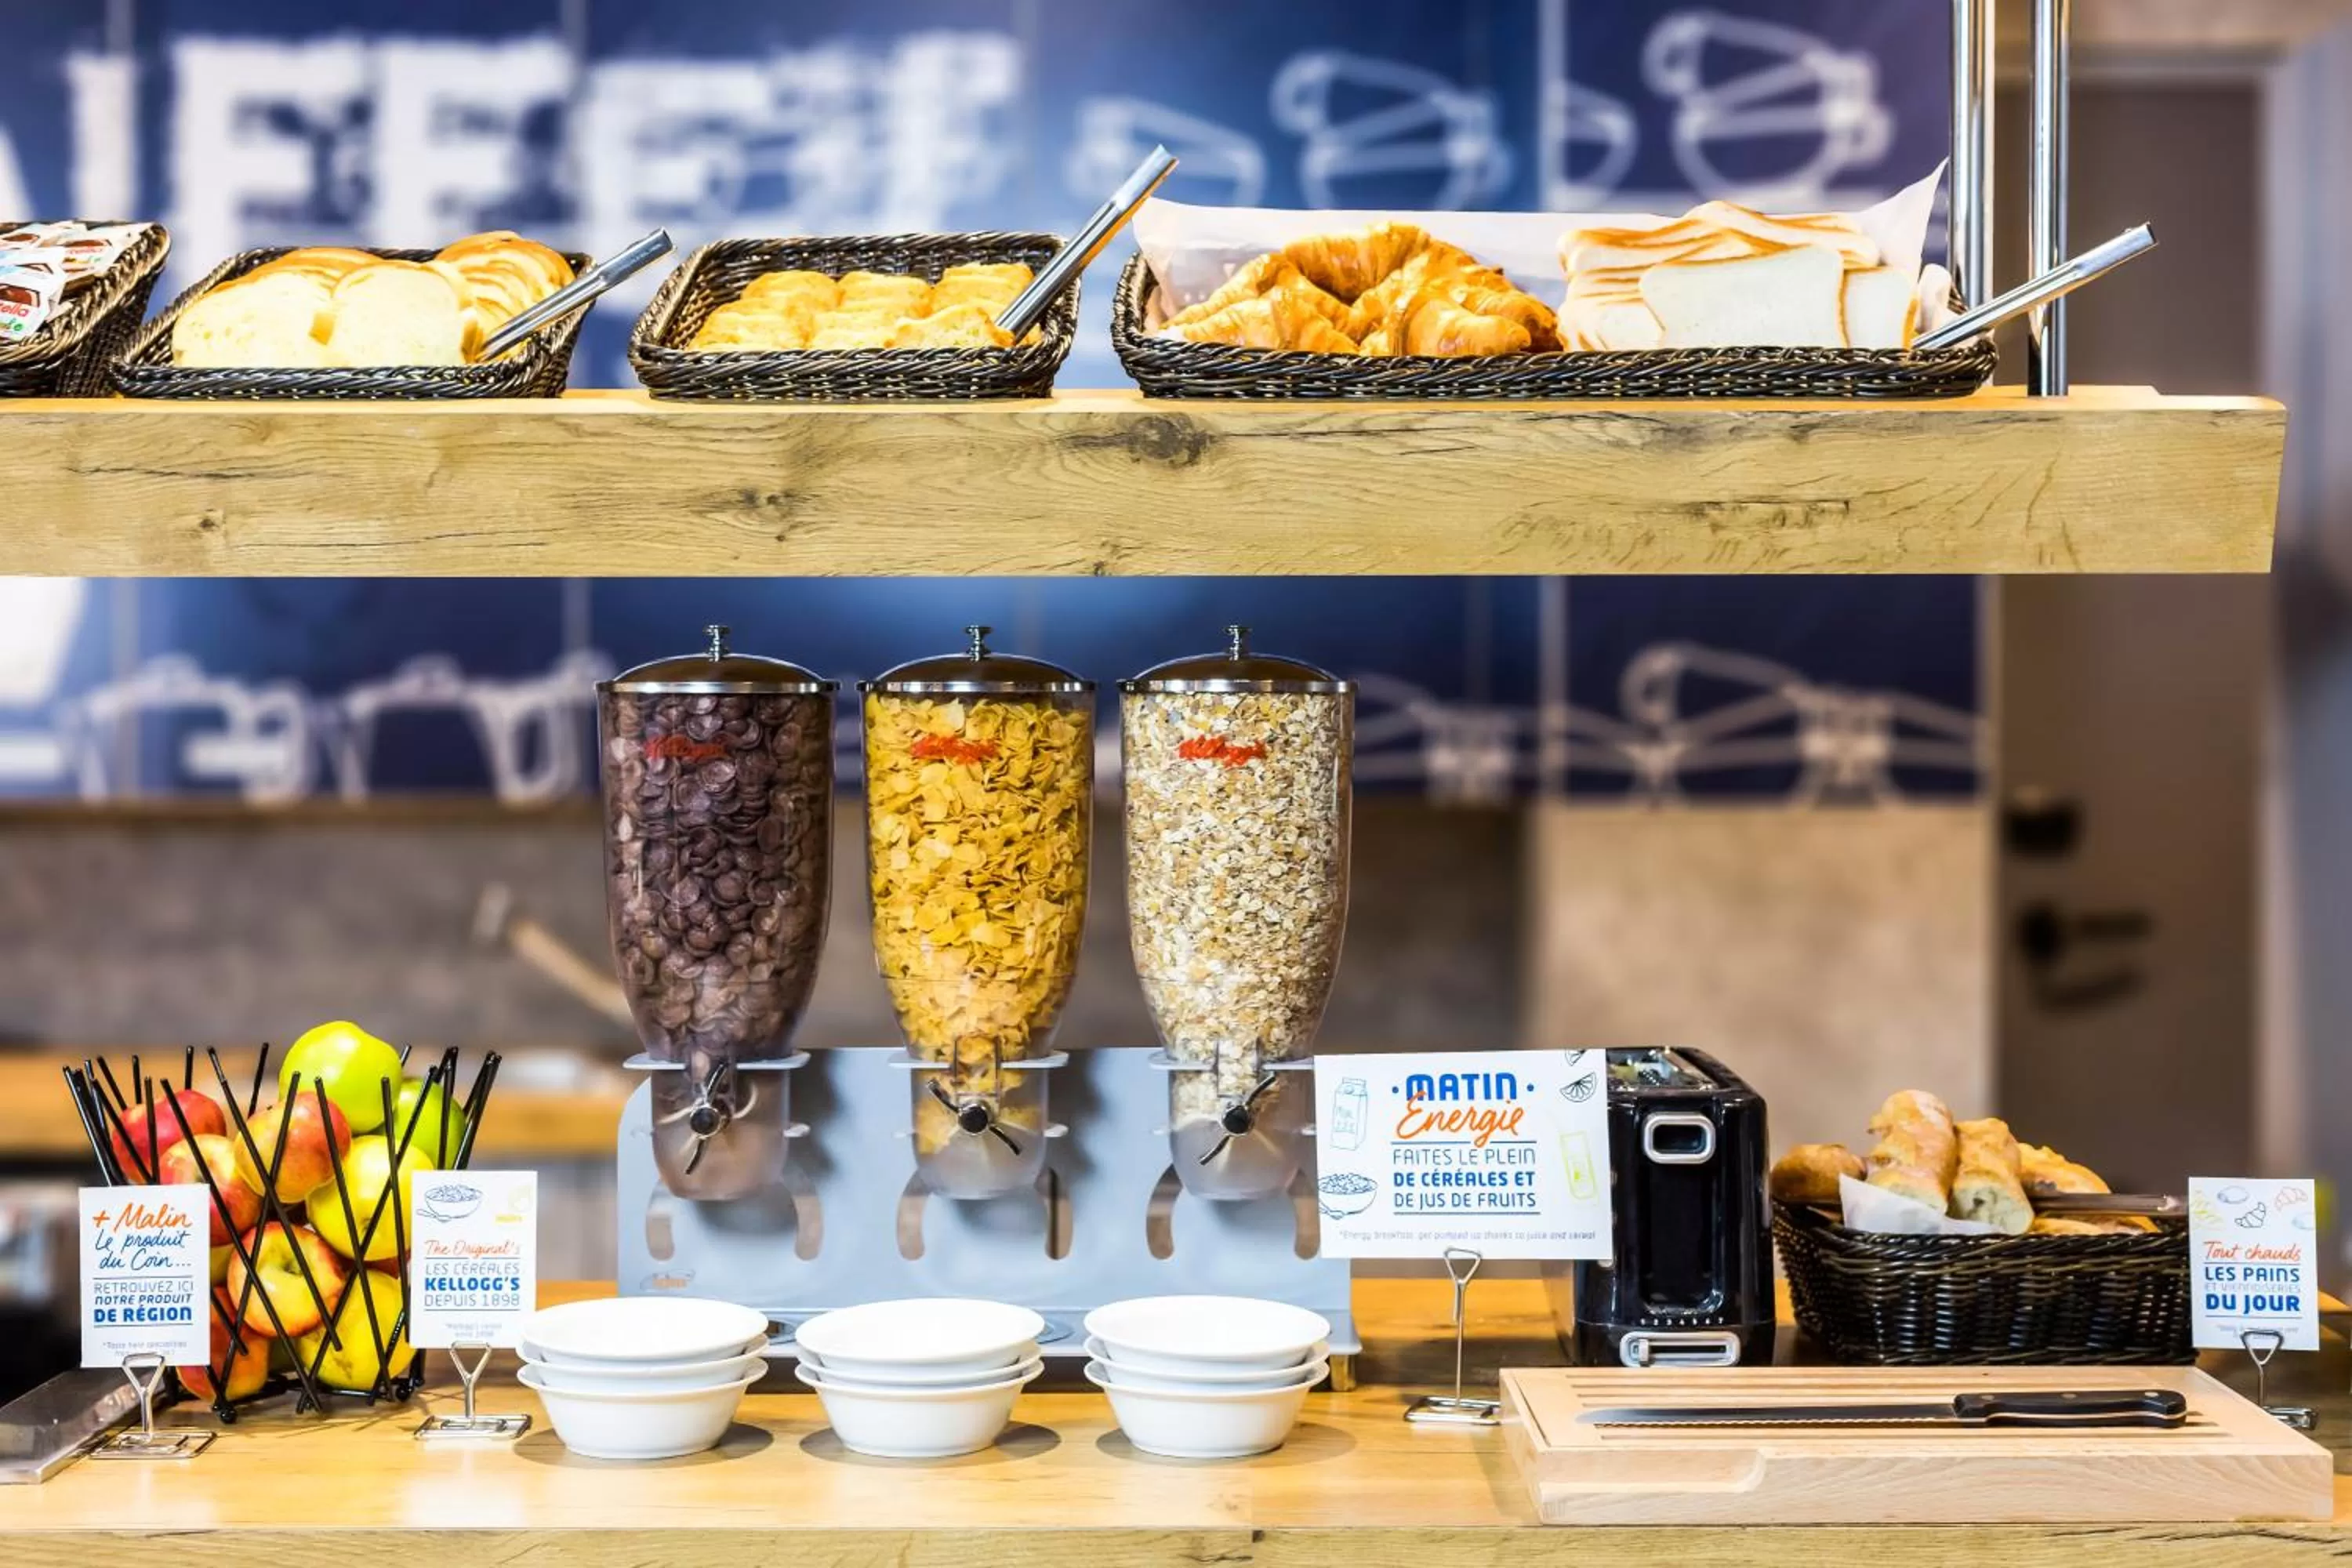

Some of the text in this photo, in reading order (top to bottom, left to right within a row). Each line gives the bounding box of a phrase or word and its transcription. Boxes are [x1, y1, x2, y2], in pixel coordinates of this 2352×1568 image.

[1406, 1072, 1518, 1102] MATIN
[1393, 1148, 1537, 1165] FAITES LE PLEIN
[1394, 1167, 1534, 1187] DE CÉRÉALES ET
[1394, 1192, 1537, 1210] DE JUS DE FRUITS
[114, 1203, 193, 1233] Malin
[95, 1229, 191, 1253] Le produit
[425, 1240, 450, 1255] The
[2204, 1241, 2302, 1261] Tout chauds
[100, 1254, 125, 1269] du
[426, 1263, 448, 1276] LES
[2205, 1267, 2300, 1282] LES PAINS
[93, 1280, 194, 1294] RETROUVEZ ICI
[425, 1277, 521, 1290] KELLOGG'S
[95, 1294, 192, 1305] NOTRE PRODUIT
[425, 1294, 521, 1307] DEPUIS 1898
[2205, 1294, 2300, 1315] DU JOUR
[94, 1304, 192, 1323] DE RÉGION
